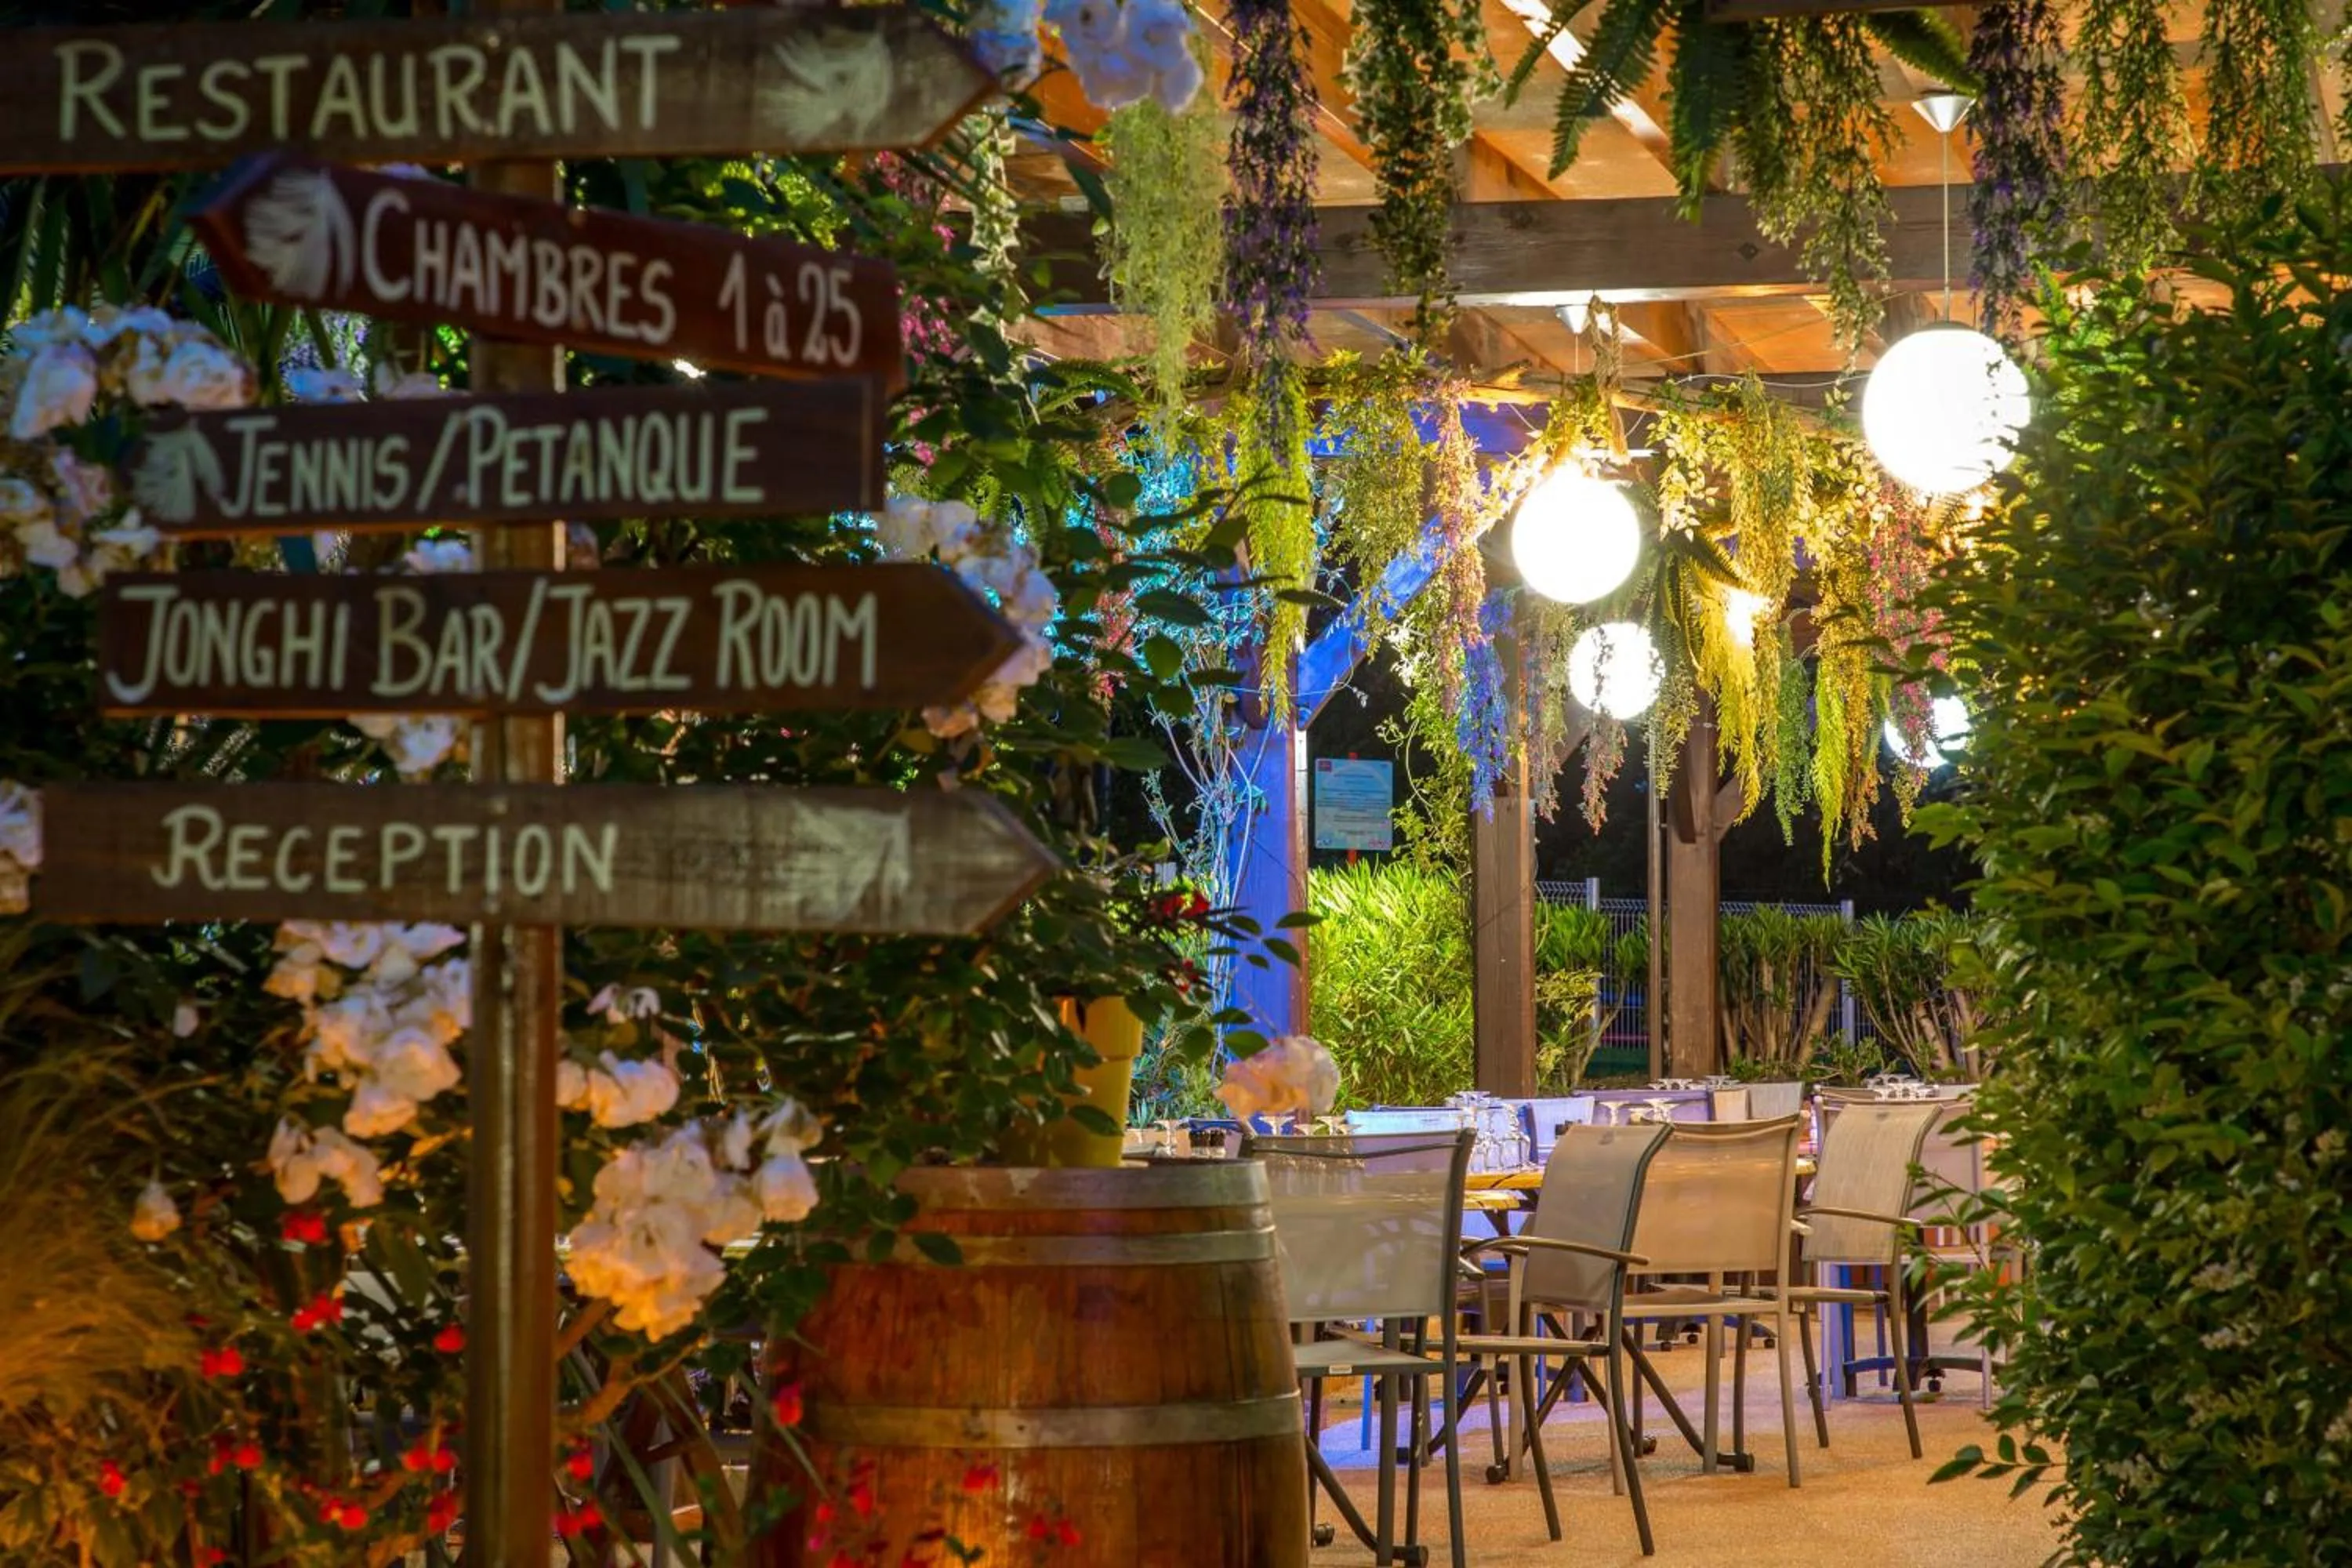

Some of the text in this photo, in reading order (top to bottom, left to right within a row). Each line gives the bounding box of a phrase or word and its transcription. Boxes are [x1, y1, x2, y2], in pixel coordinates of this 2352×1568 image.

[54, 36, 681, 143] RESTAURANT
[361, 190, 677, 346] CHAMBRES
[717, 252, 750, 353] 1
[797, 263, 862, 366] 25
[105, 584, 350, 703] JONGHI
[713, 579, 877, 690] ROOM
[151, 804, 619, 898] RECEPTION
